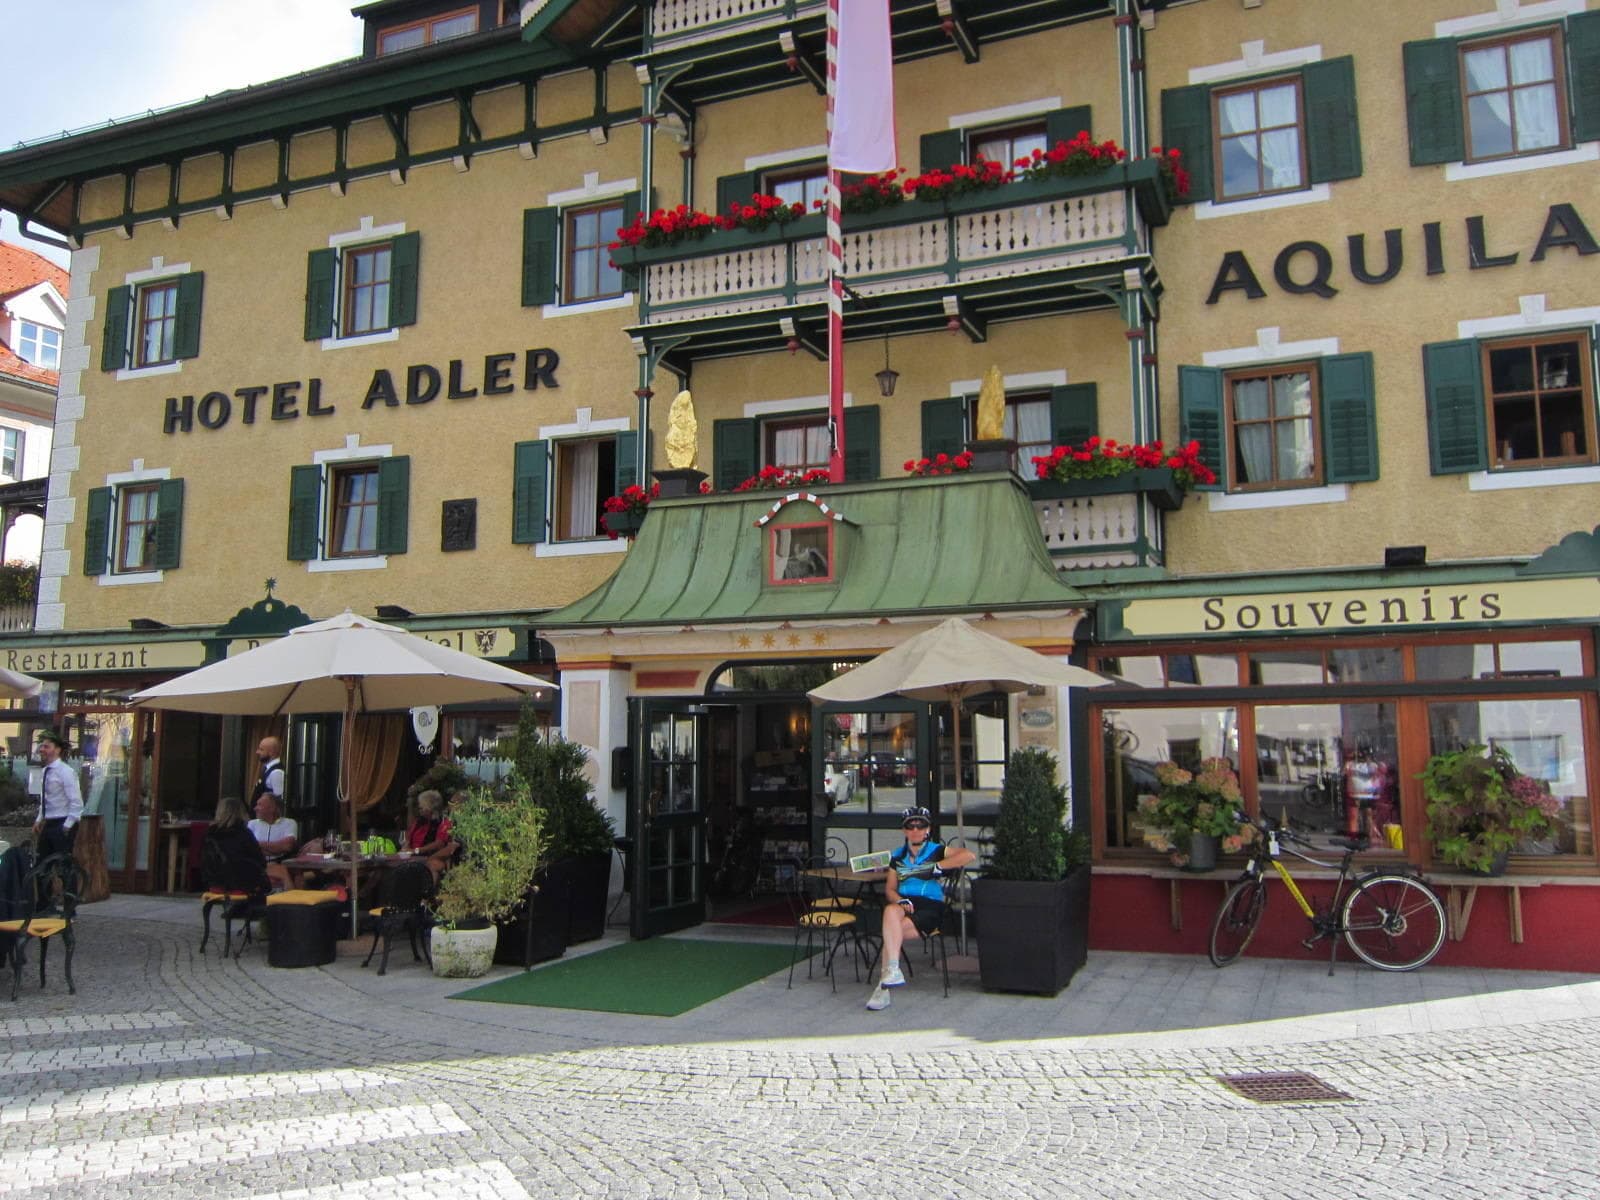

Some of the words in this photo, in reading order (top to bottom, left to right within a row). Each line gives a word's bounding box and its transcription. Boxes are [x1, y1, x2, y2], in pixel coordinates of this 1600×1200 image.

[1205, 202, 1600, 305] AQUILA
[163, 378, 335, 434] HOTEL
[361, 347, 560, 410] ADLER
[1203, 588, 1501, 631] Souvenirs
[8, 646, 148, 672] Restaurant
